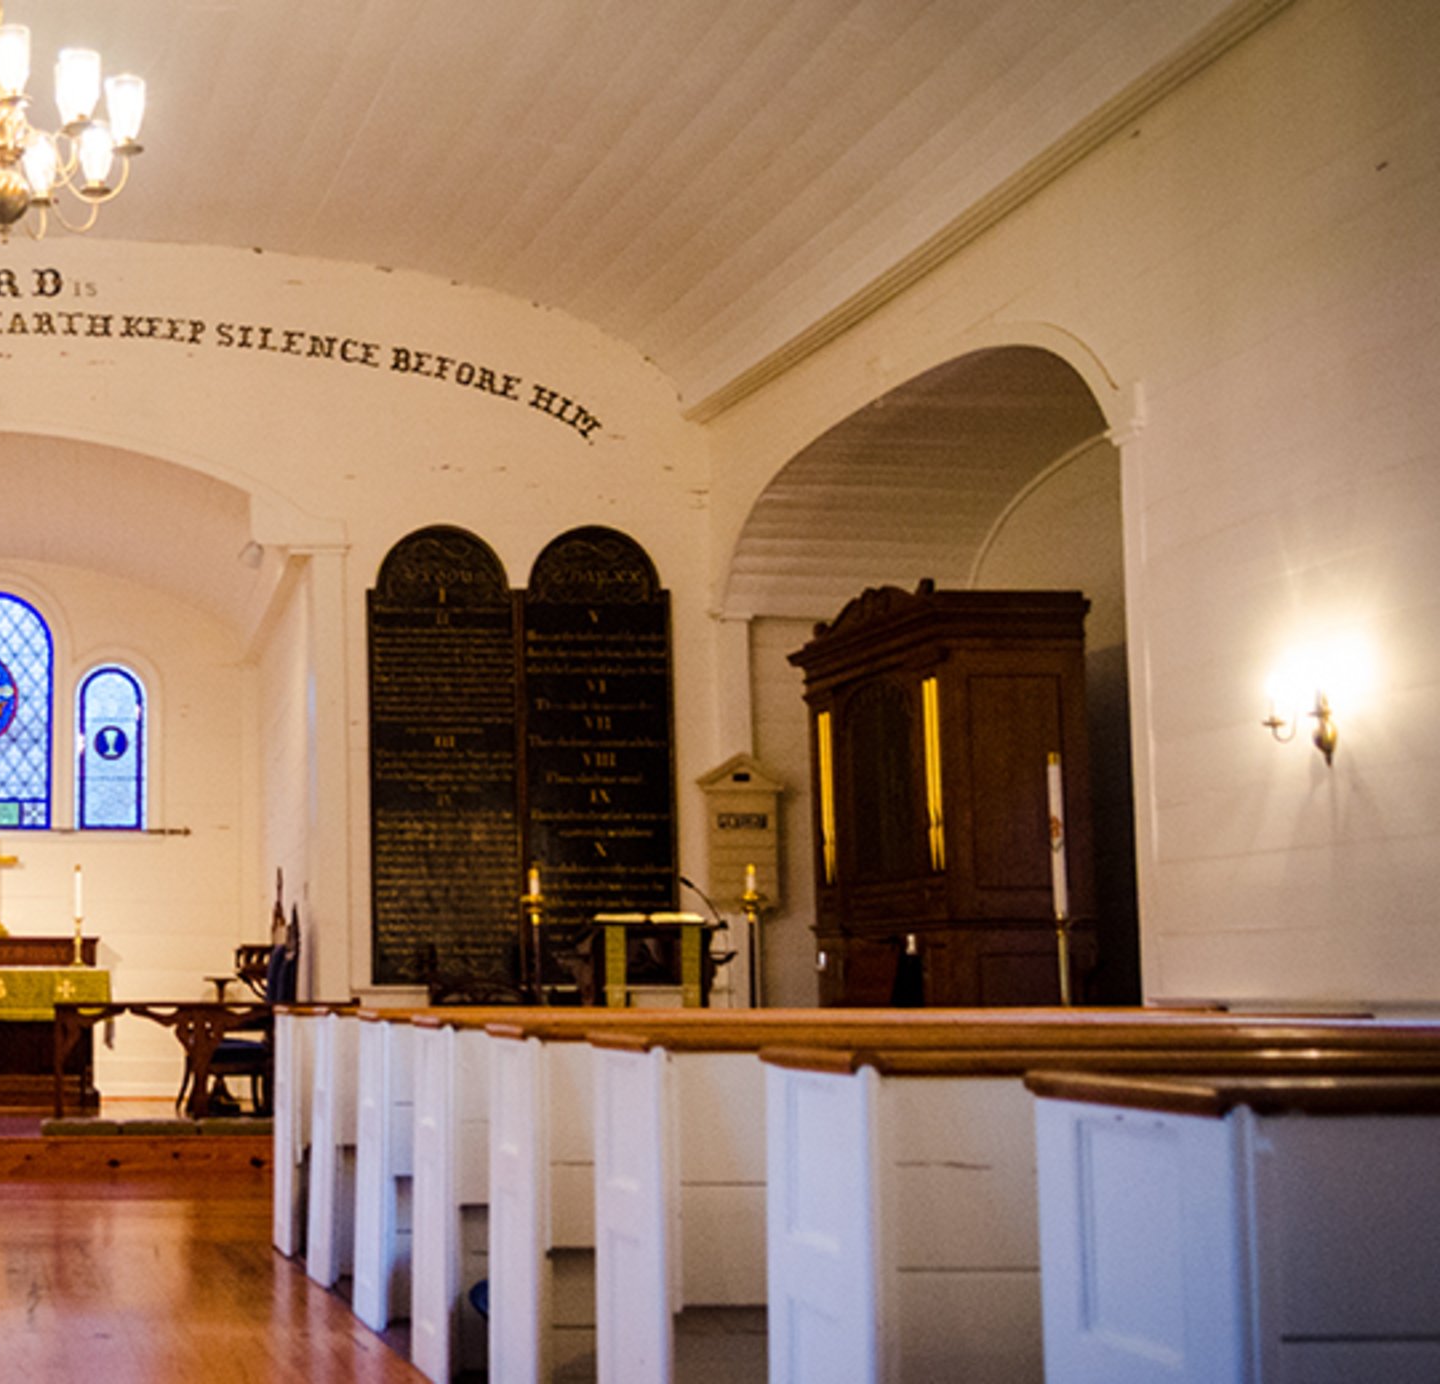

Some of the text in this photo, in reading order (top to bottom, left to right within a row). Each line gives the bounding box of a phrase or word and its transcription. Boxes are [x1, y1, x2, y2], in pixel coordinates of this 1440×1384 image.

[73, 281, 98, 297] IS
[118, 314, 208, 346] KEEP
[215, 321, 380, 369] SILENCE
[388, 345, 523, 401] BEFORE
[586, 679, 607, 695] VI
[583, 715, 612, 731] VII
[433, 735, 456, 749] III
[581, 751, 617, 768] VIII
[590, 788, 613, 805] IX
[594, 841, 609, 858] X
